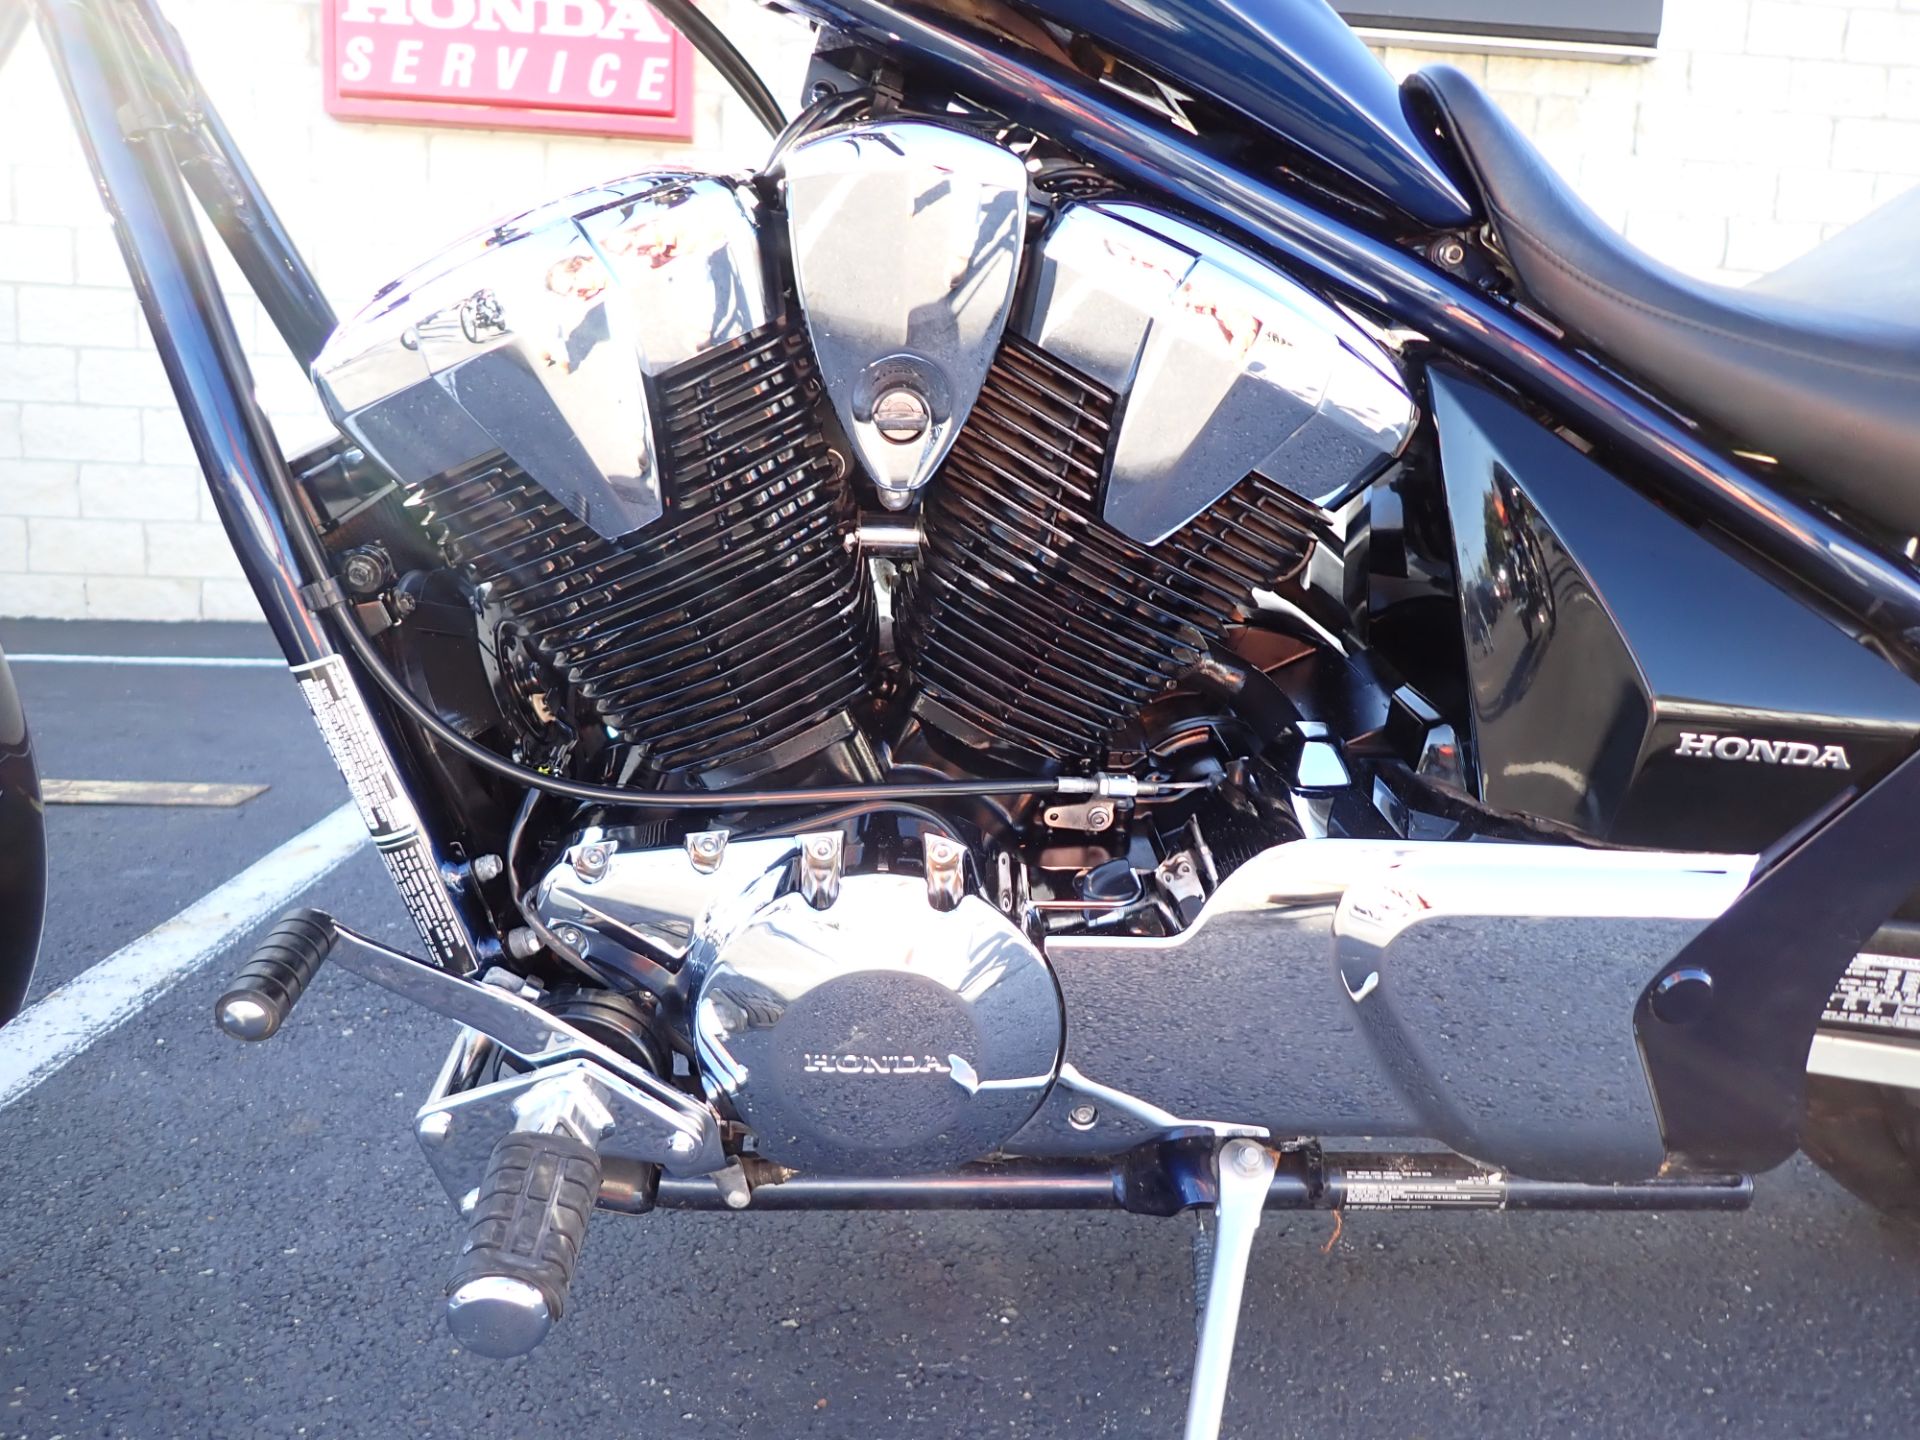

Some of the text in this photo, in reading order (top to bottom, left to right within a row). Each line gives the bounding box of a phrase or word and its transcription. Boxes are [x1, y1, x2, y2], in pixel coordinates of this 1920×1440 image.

[341, 0, 671, 43] HONDA
[341, 37, 670, 100] SERVICE
[1674, 732, 1851, 770] HONDA
[804, 1053, 951, 1074] HONDA
